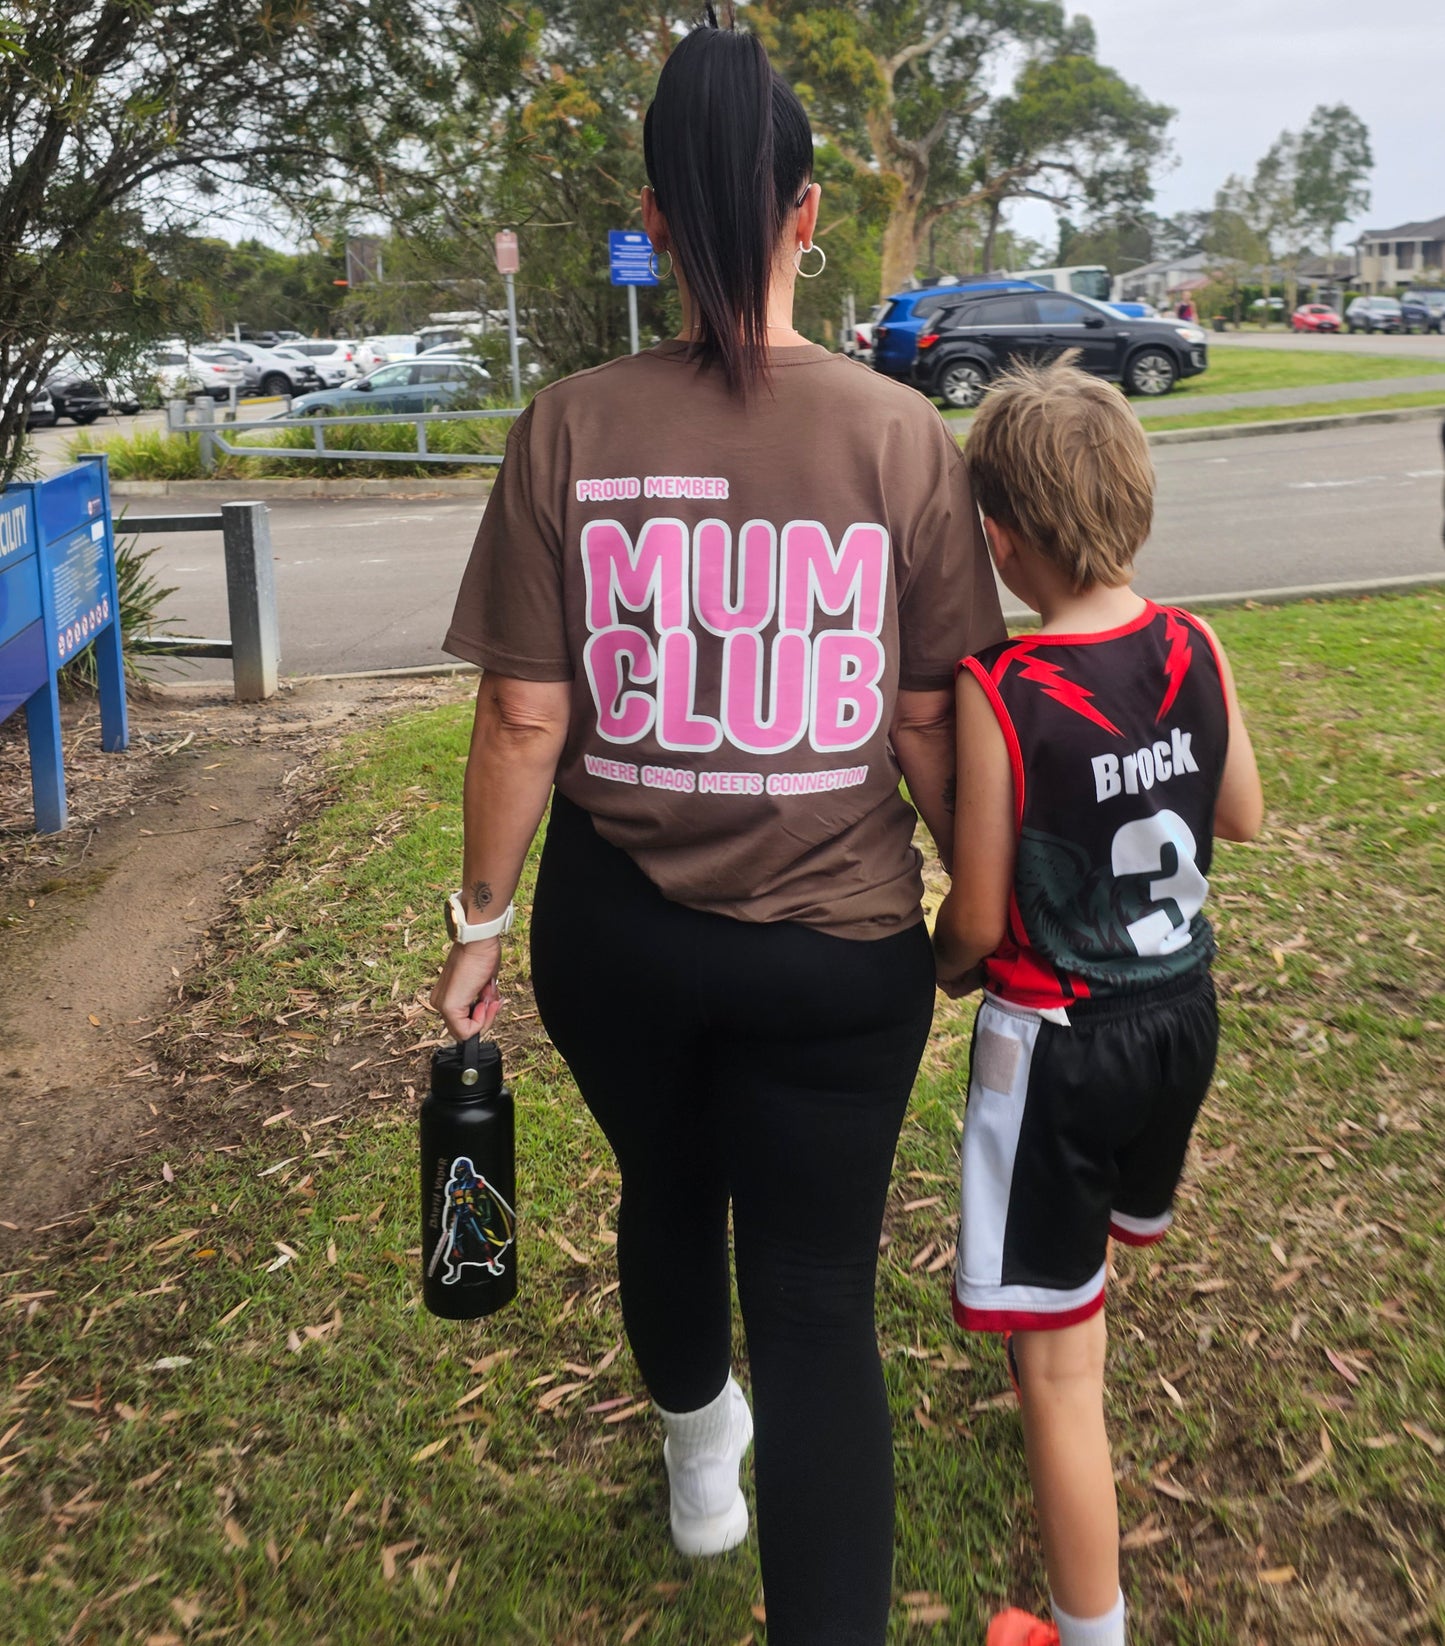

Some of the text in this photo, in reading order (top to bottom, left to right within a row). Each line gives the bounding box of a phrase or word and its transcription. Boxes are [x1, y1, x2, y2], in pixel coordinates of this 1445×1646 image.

[577, 477, 729, 501] PROUD MEMBER
[0, 504, 27, 558] CILITY
[581, 518, 889, 637] MUM
[583, 624, 885, 754] CLUB
[584, 754, 869, 796] WHERE CHAOS MEETS CONNECTION
[1091, 727, 1200, 803] Brock
[1111, 809, 1209, 956] 3
